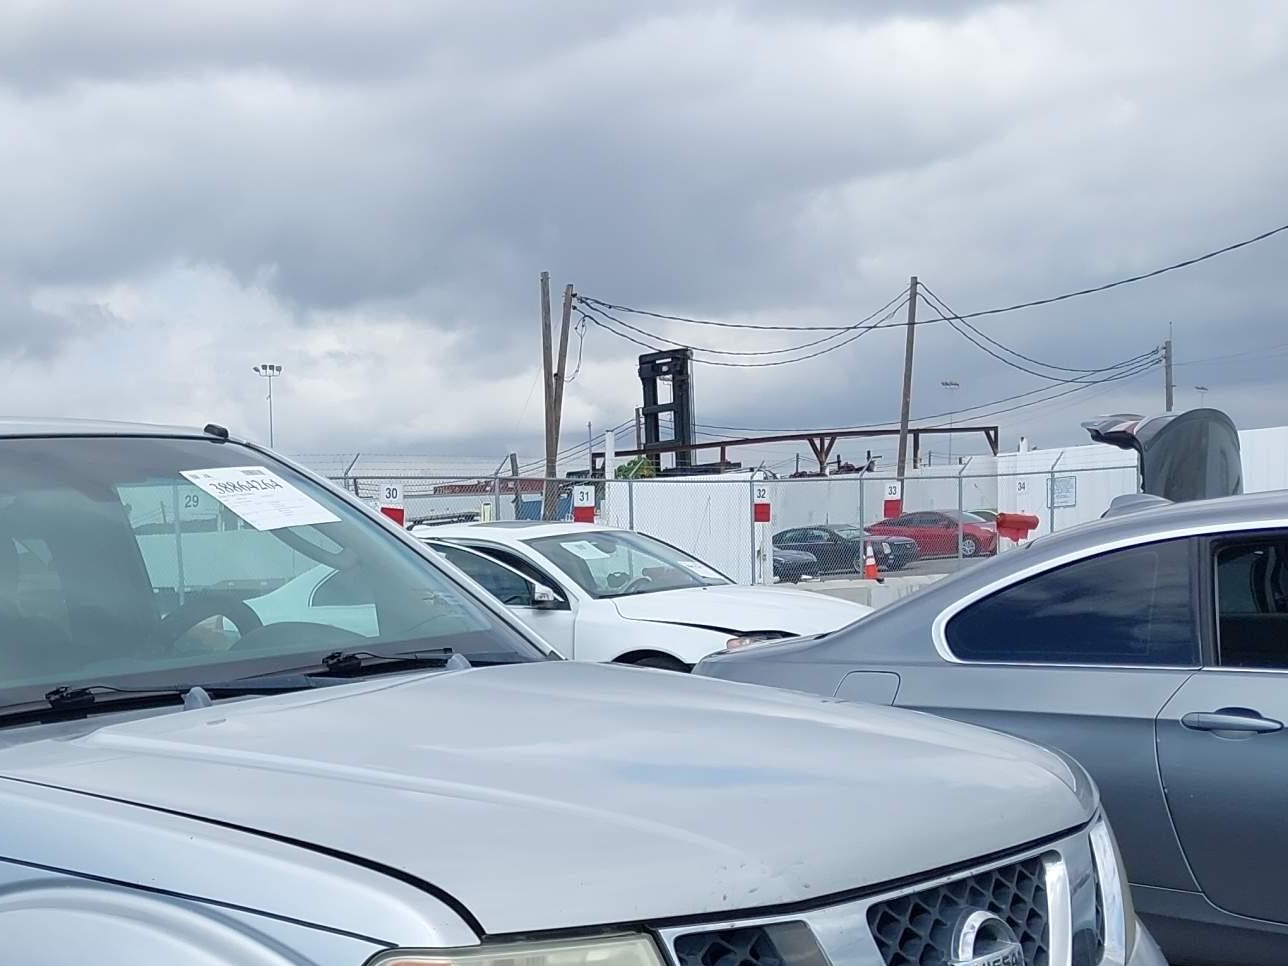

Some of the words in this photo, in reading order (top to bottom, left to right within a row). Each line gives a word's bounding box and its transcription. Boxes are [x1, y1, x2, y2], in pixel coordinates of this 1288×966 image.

[209, 479, 284, 495] 38864264
[888, 486, 897, 495] 33
[1017, 481, 1026, 491] 34
[385, 487, 398, 499] 30
[579, 491, 589, 502] 31
[756, 488, 767, 498] 32
[184, 495, 200, 508] 29
